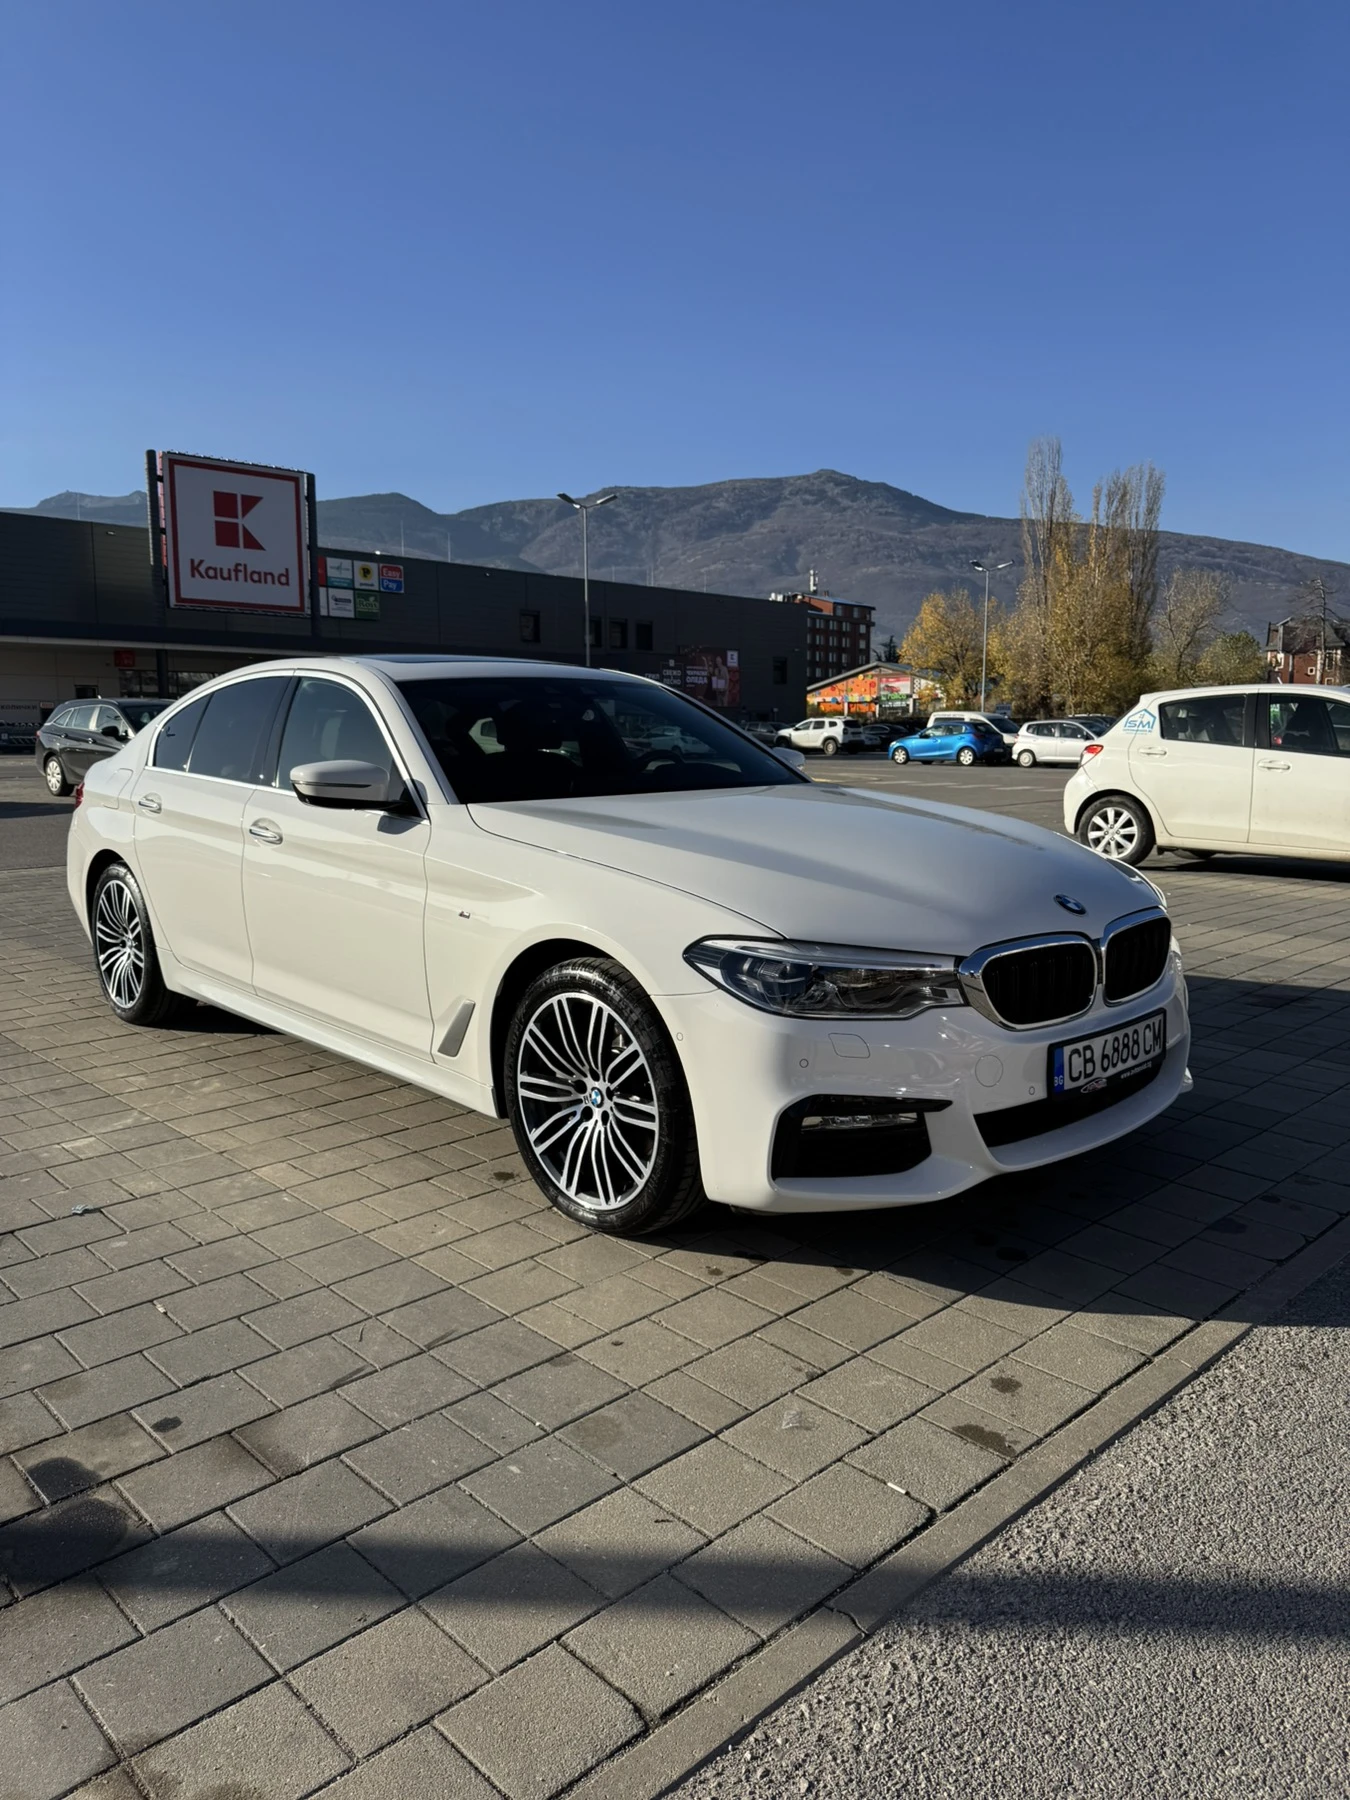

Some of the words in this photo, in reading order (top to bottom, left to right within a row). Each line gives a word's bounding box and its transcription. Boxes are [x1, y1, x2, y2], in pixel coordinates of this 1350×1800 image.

[213, 490, 266, 551] K
[190, 558, 290, 586] Kaufland
[383, 568, 401, 578] Easy
[383, 579, 397, 590] Pay
[1069, 1045, 1096, 1082] CB
[1101, 1029, 1140, 1072] 6888
[1143, 1019, 1161, 1055] CM
